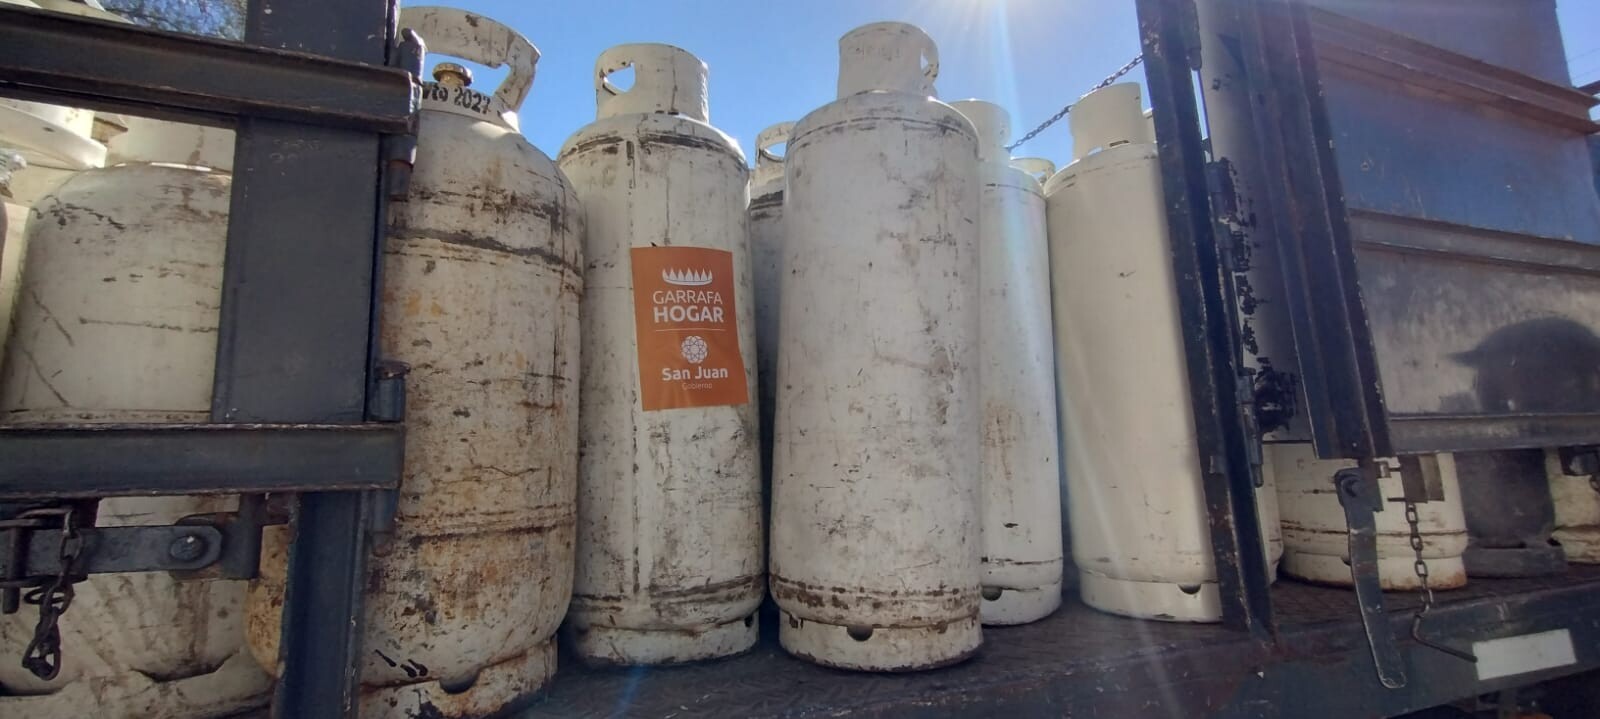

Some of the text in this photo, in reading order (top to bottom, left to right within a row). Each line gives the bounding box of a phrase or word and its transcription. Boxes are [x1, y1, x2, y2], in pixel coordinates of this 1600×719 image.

[454, 86, 491, 114] 2027
[652, 290, 723, 304] GARRAFA
[653, 305, 724, 323] HOGAR
[662, 366, 728, 381] San Juan
[682, 382, 713, 390] Gobierno
